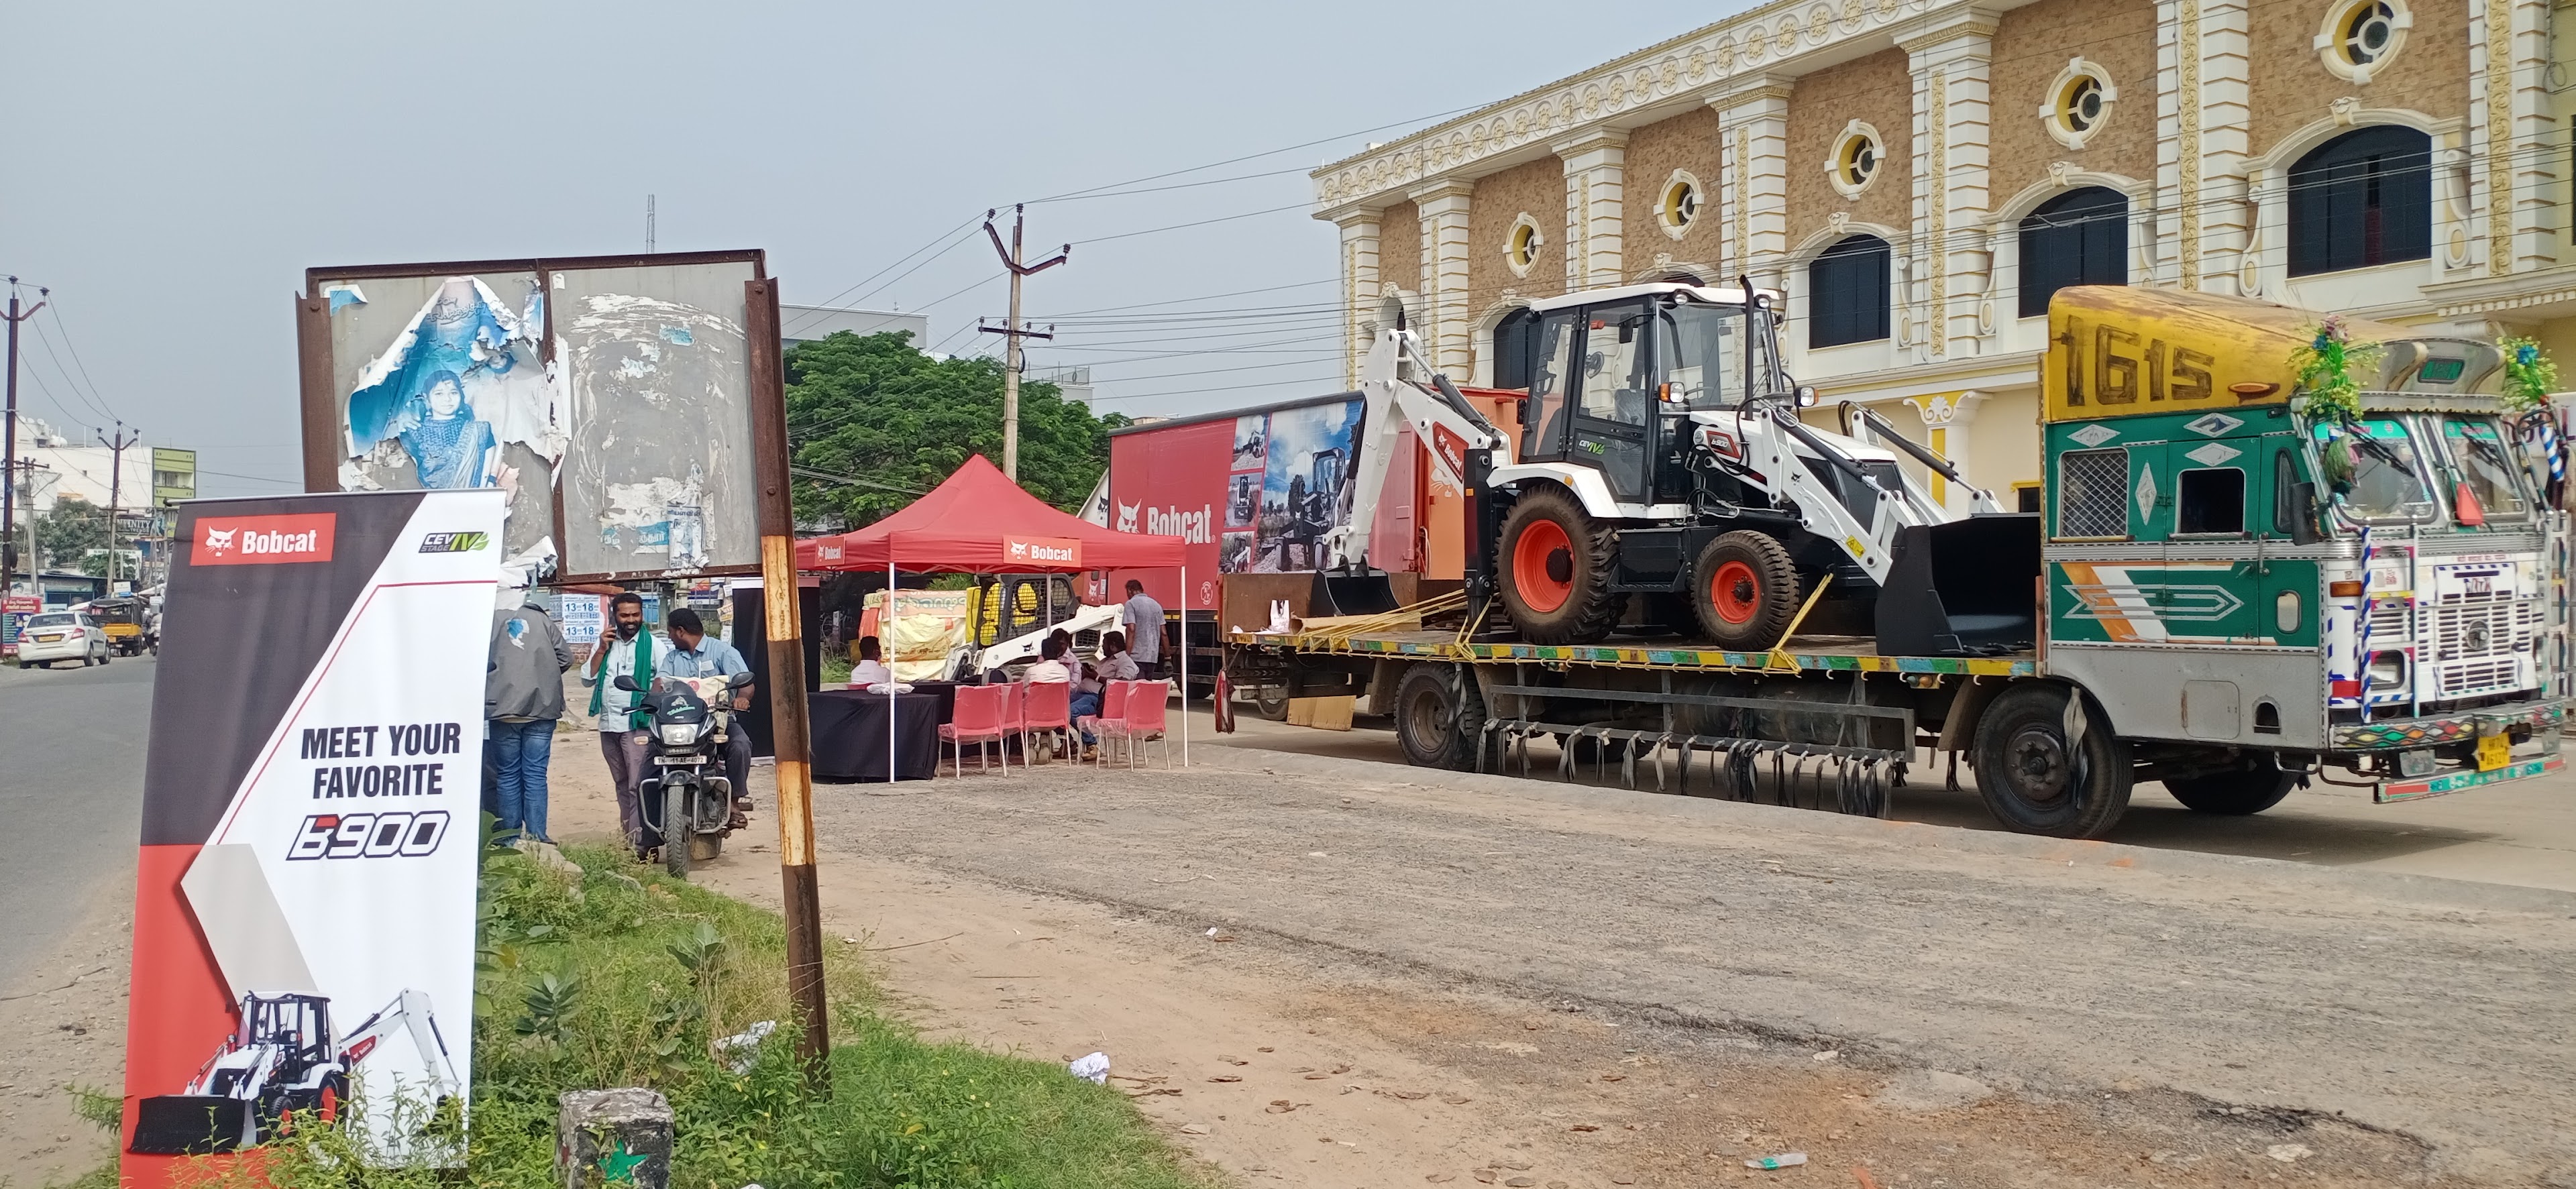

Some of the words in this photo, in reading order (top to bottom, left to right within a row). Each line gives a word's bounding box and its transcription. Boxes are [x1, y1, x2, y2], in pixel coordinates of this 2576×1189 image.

[2061, 314, 2215, 407] 1615
[1444, 443, 1463, 473] Bobcat
[1147, 504, 1212, 545] Bobcat
[242, 528, 317, 555] Bobcat
[421, 544, 451, 553] STAGE
[424, 533, 457, 545] CEV
[824, 545, 841, 561] Bobcat
[1030, 545, 1073, 561] Bobcat
[566, 603, 577, 612] 13
[582, 603, 594, 612] 18
[566, 626, 577, 636] 13
[583, 626, 594, 635] 18
[301, 726, 379, 759] MEET
[388, 722, 462, 756] YOUR
[313, 763, 444, 799] FAVORITE
[286, 810, 450, 861] B900
